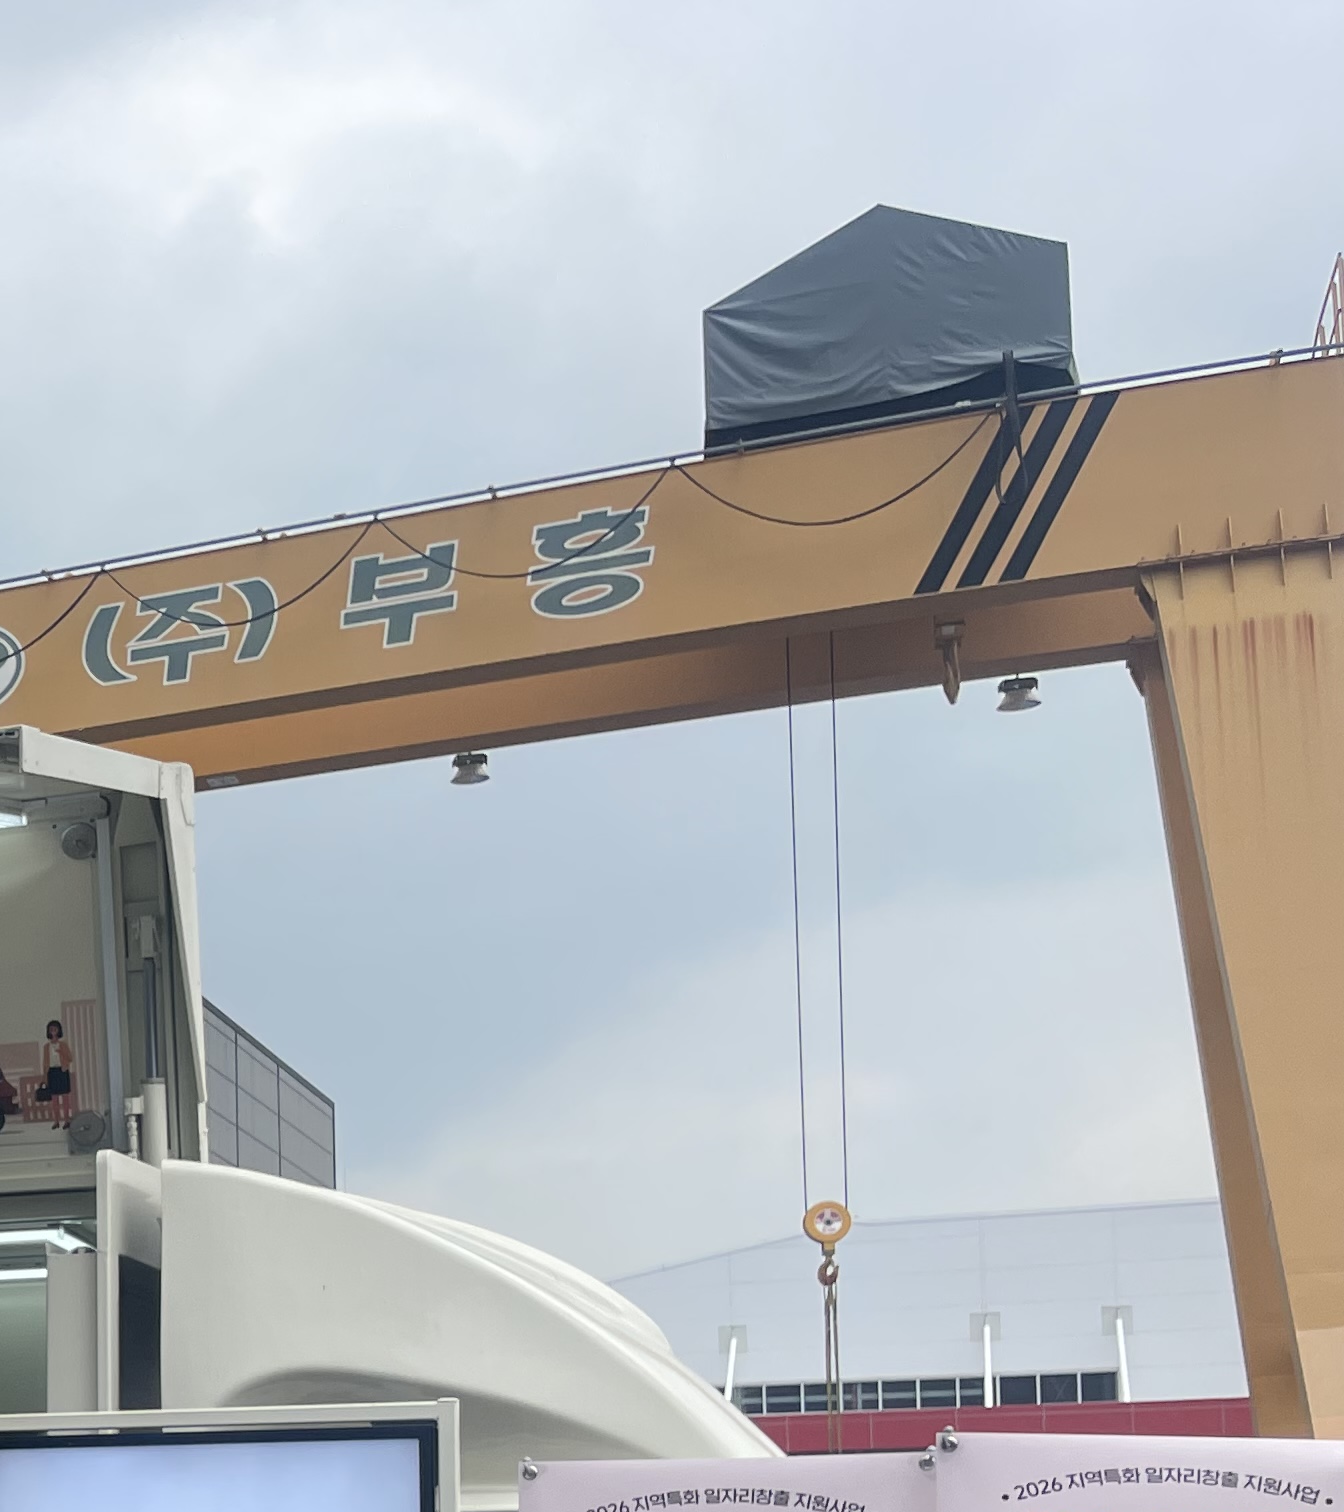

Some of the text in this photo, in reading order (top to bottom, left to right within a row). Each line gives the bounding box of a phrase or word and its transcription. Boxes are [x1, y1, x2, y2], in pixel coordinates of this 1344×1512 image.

[83, 577, 278, 686] (주)
[634, 1490, 700, 1512] 지역특화
[704, 1488, 790, 1506] 일자리창출
[1013, 1467, 1321, 1505] 2026 지역특화 일자리창출 지원사업
